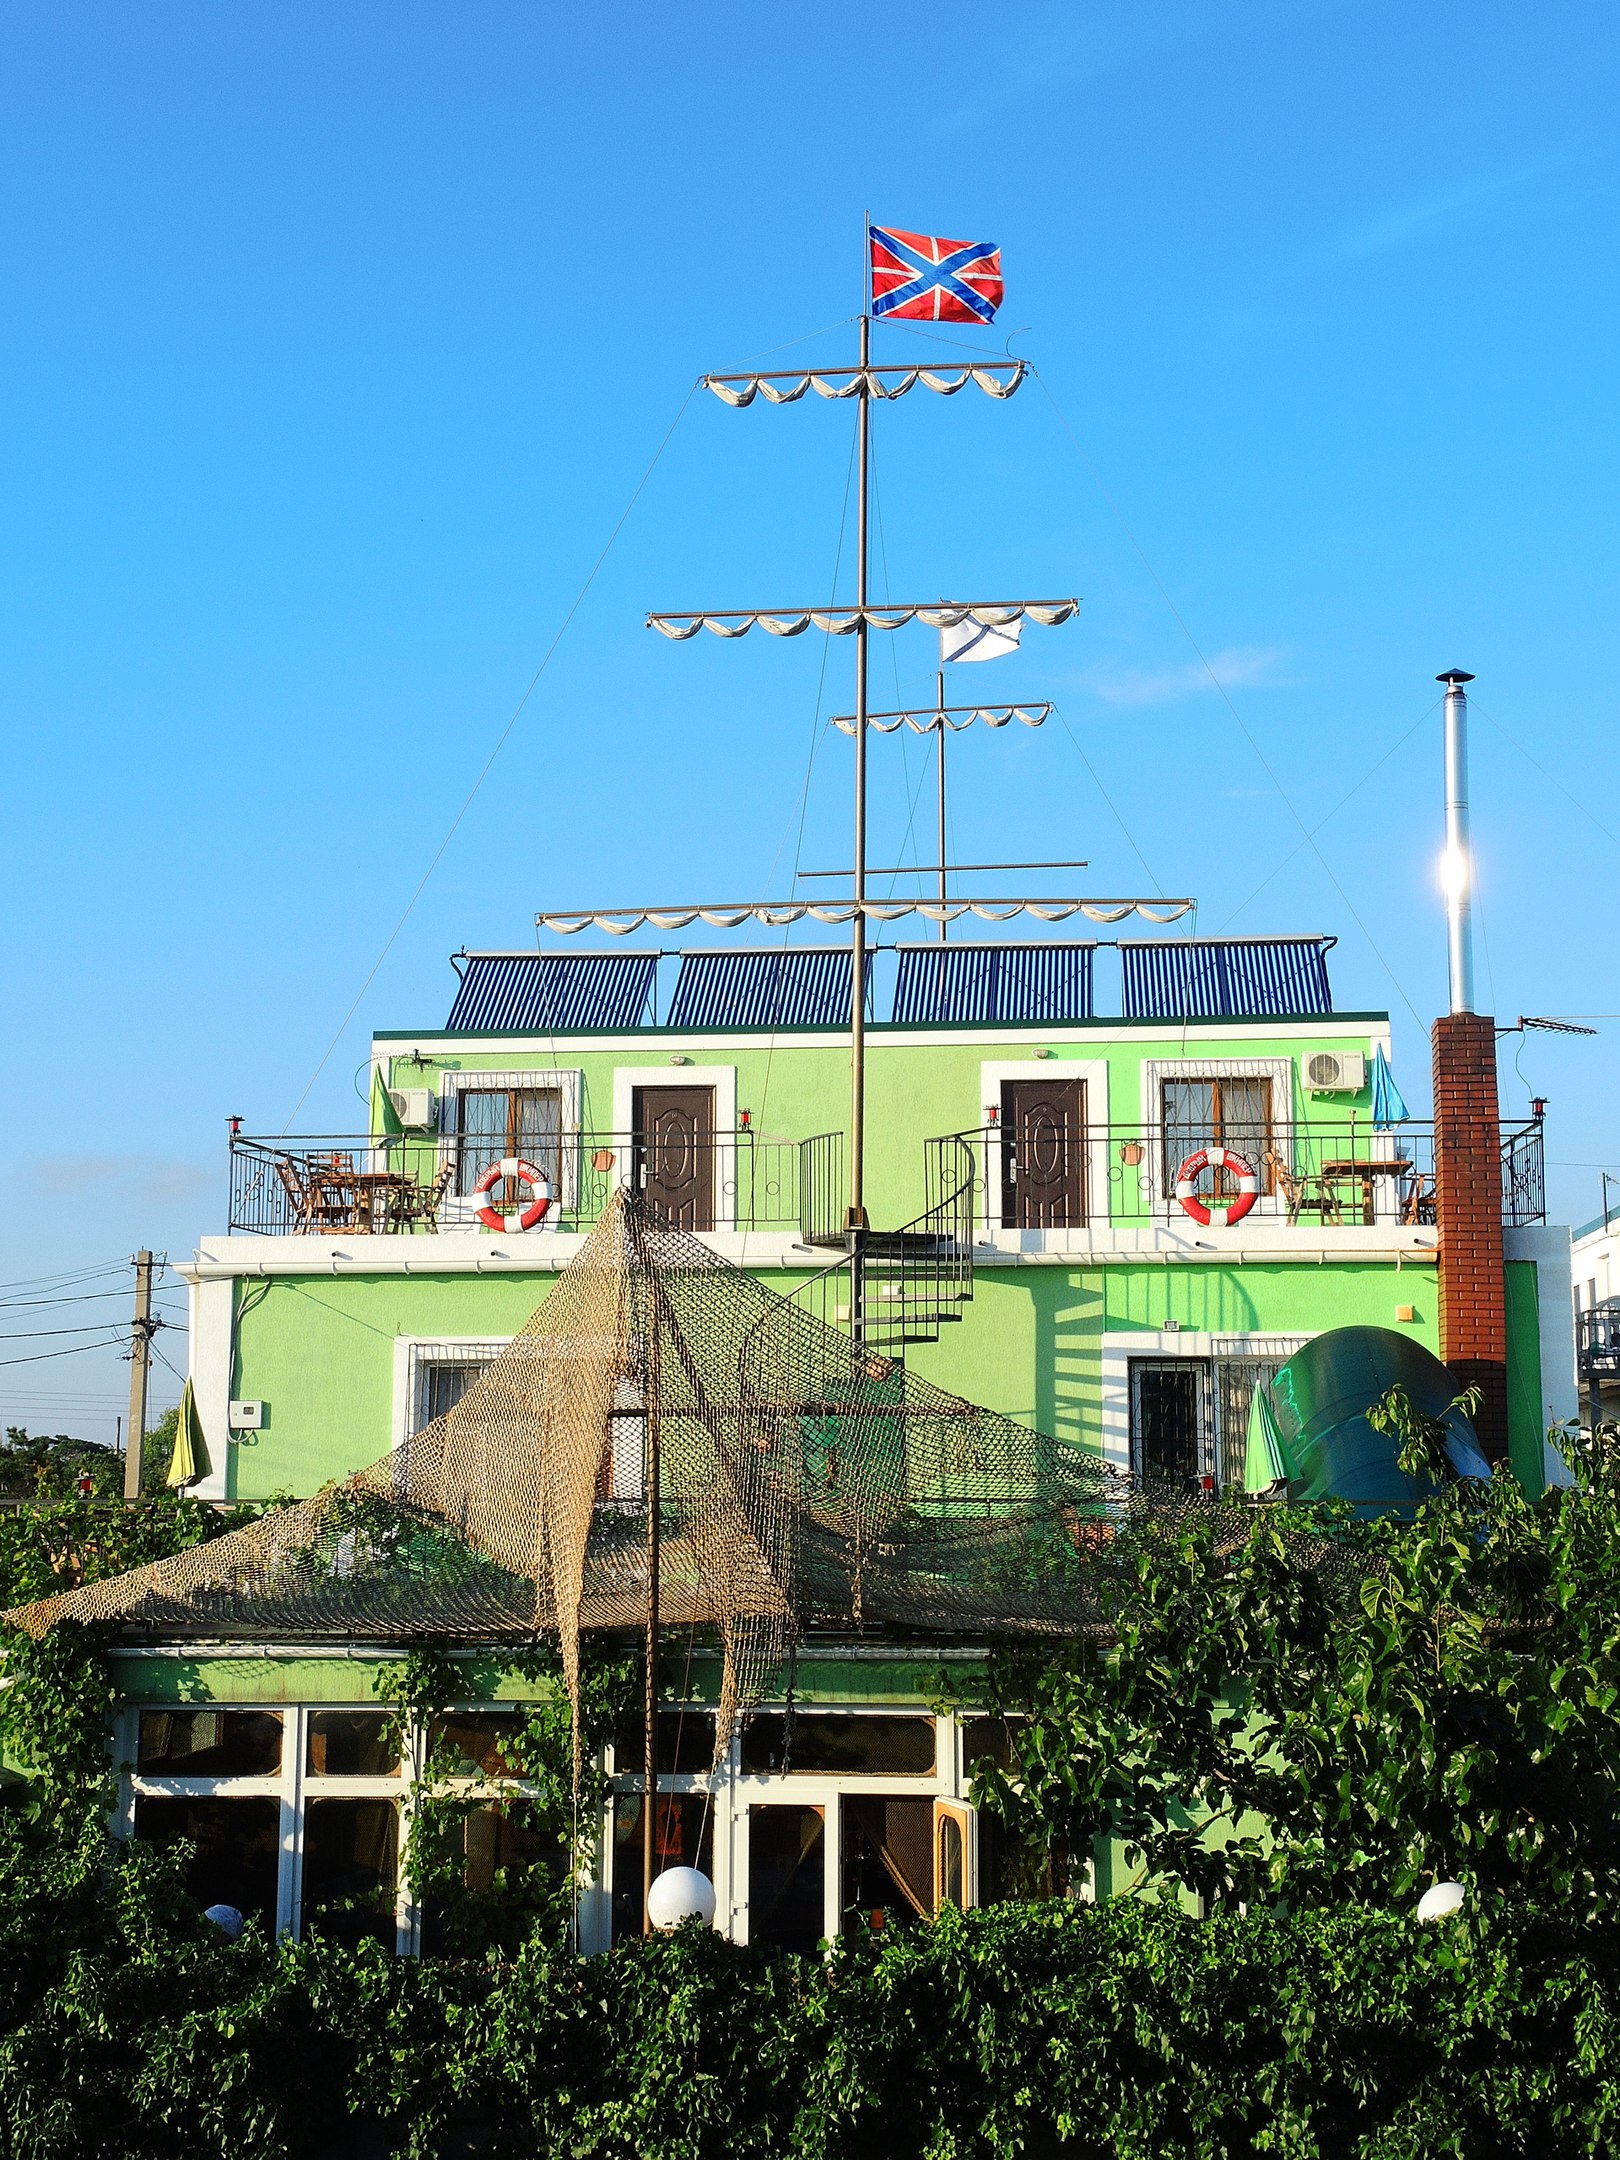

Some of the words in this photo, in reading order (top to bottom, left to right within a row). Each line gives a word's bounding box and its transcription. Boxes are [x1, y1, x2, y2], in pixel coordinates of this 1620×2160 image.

[1226, 1152, 1252, 1174] ШКИПЕР
[477, 1165, 500, 1189] ДОБРЫЙ
[519, 1163, 544, 1182] ШКИПЕР
